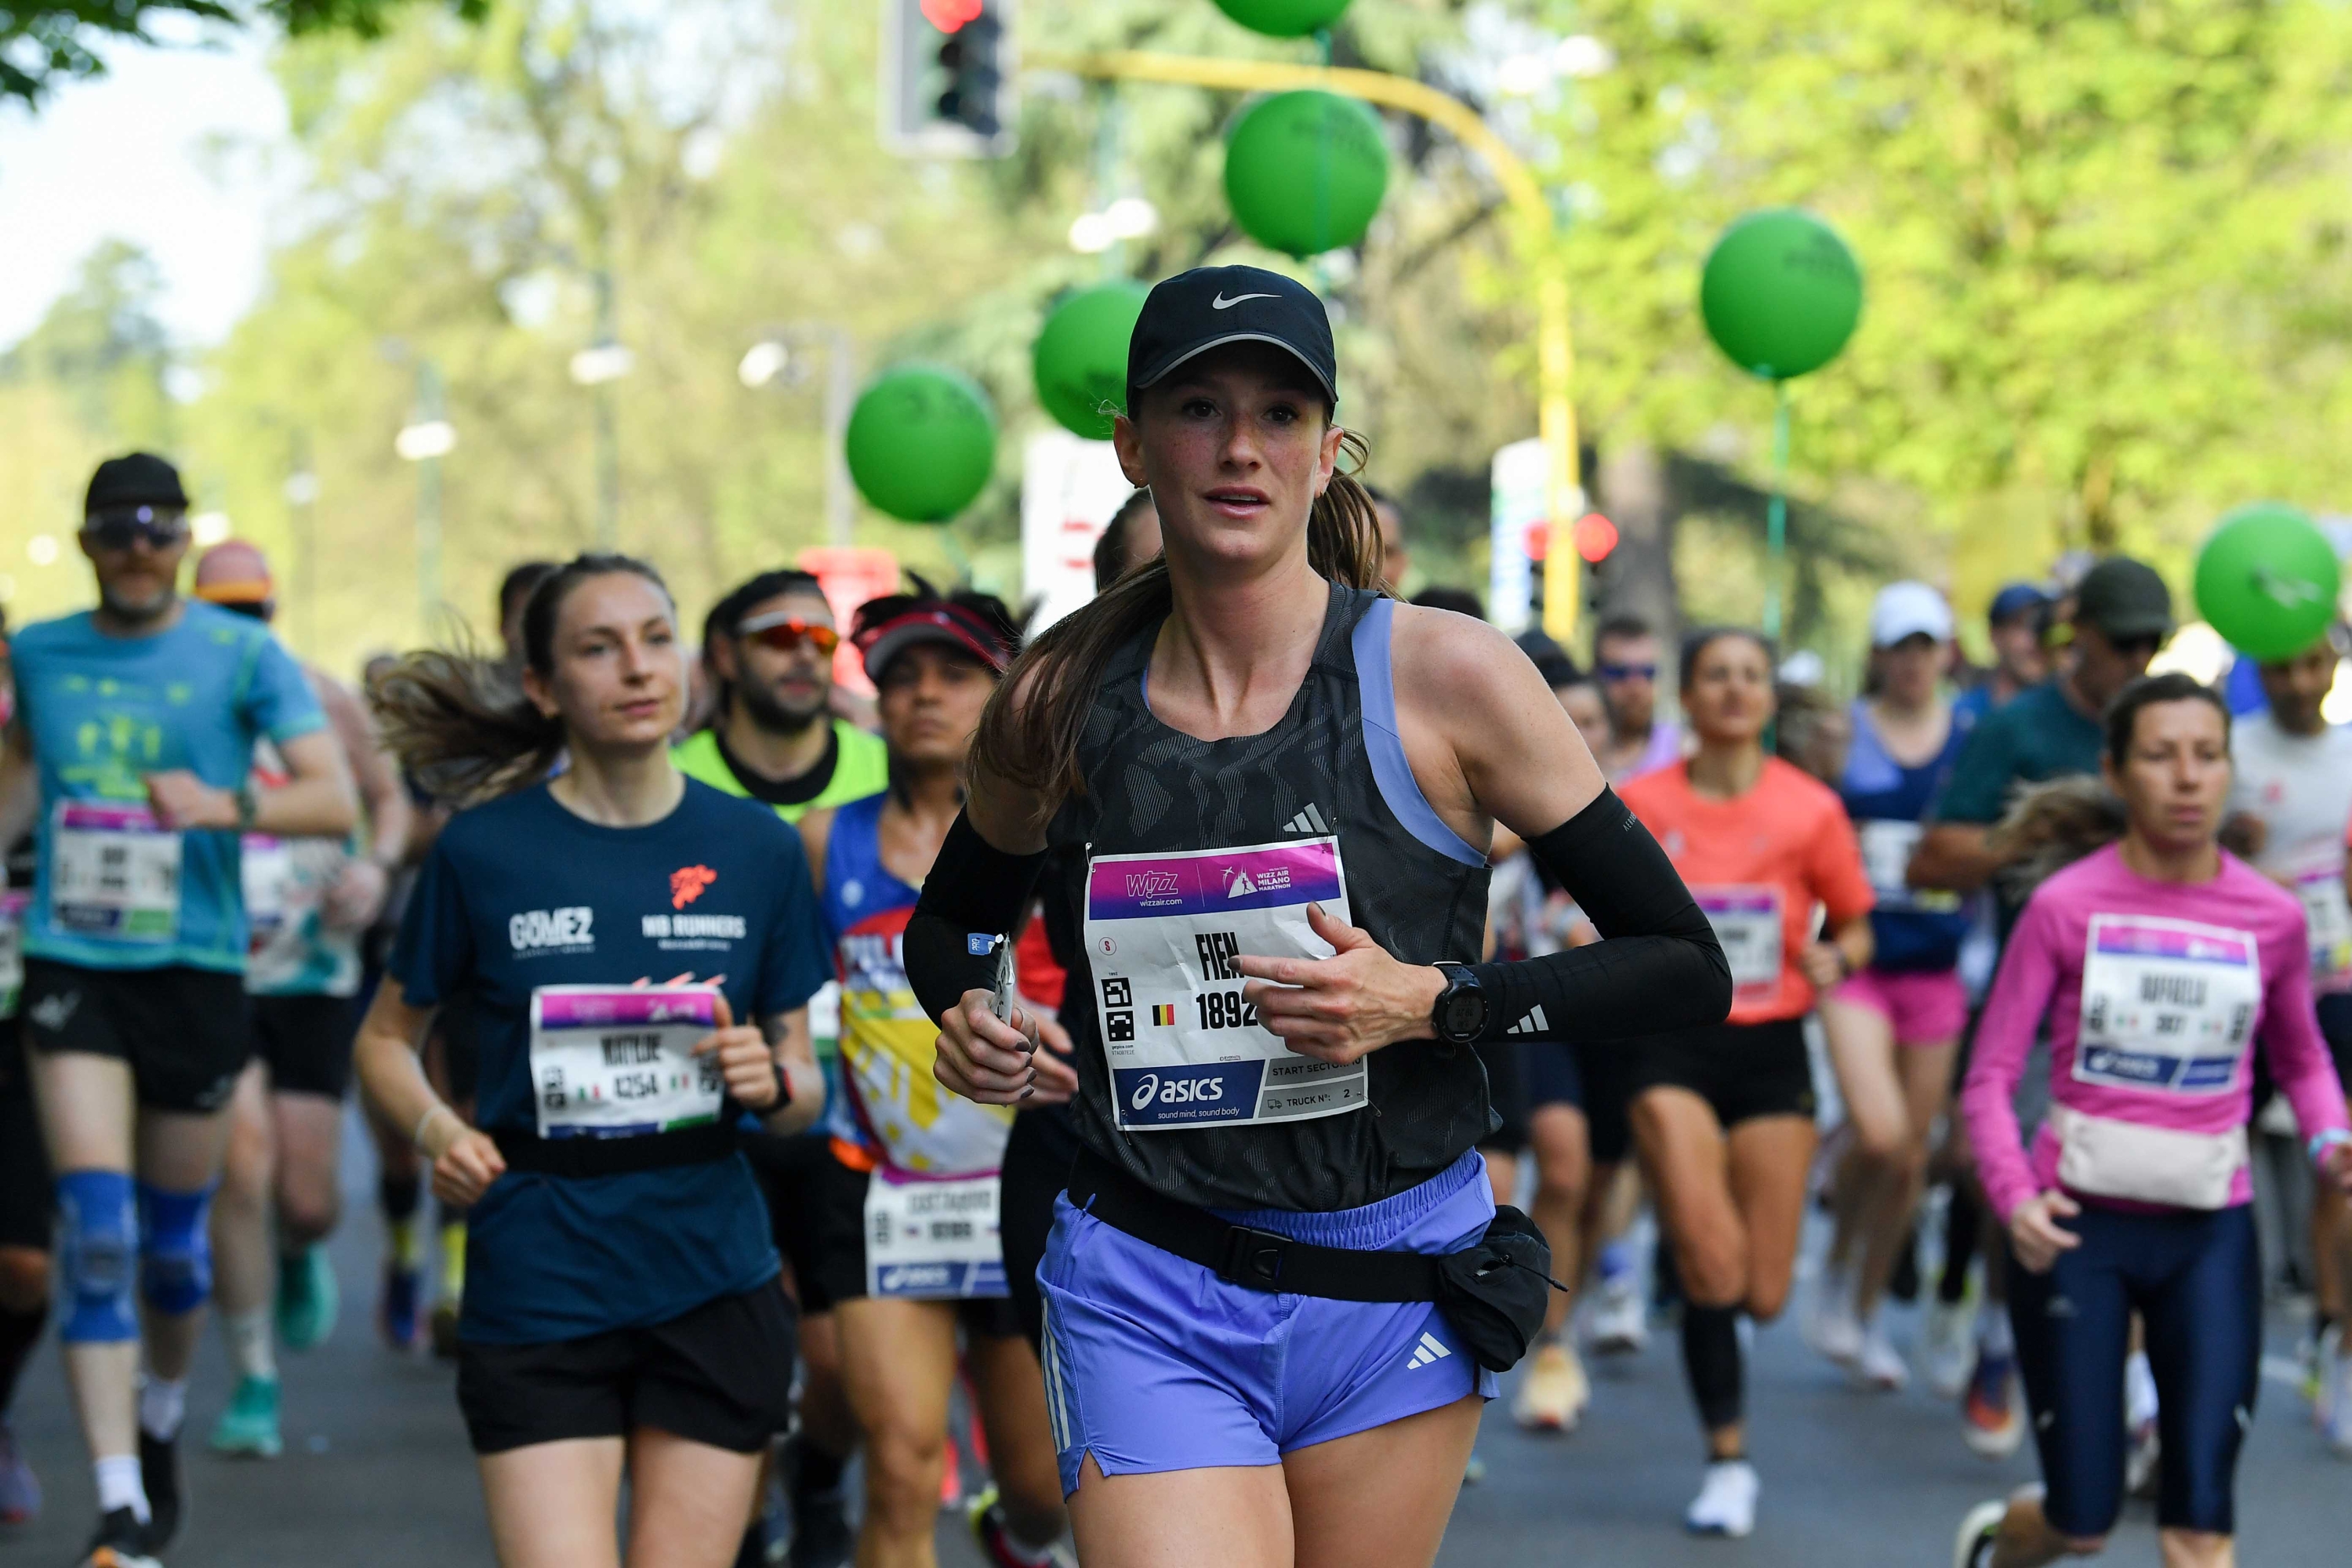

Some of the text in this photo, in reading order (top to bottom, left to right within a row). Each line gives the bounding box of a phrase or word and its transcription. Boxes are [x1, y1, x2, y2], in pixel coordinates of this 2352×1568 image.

[1258, 877, 1290, 886] MILANO
[1258, 883, 1291, 891] MARATHON
[1139, 898, 1182, 907] wizzair.com
[1196, 991, 1258, 1030] 1892
[1272, 1065, 1304, 1076] START
[1287, 1095, 1316, 1107] TRUCK
[1343, 1089, 1350, 1098] 2
[1157, 1106, 1240, 1120] sound mind, sound body
